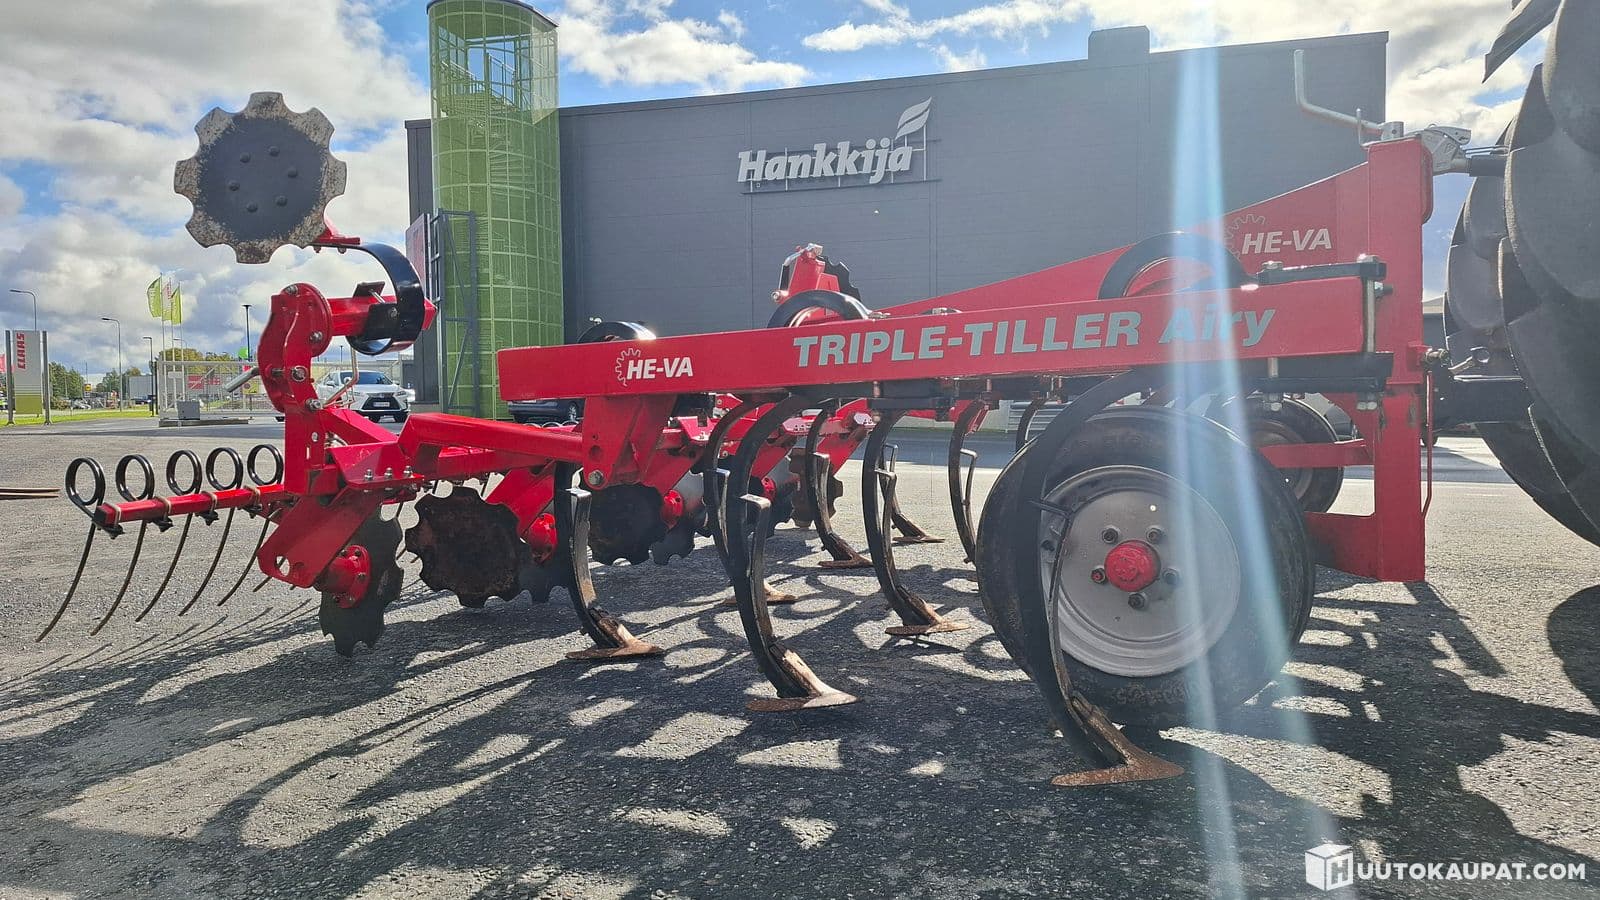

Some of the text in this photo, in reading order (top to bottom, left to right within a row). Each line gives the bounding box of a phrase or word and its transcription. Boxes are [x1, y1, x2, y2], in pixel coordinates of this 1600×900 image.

[737, 137, 912, 184] Hankkija
[1241, 228, 1332, 255] HE-VA
[793, 303, 1276, 367] TRIPLE-TILLER Airy
[626, 357, 693, 380] HE-VA
